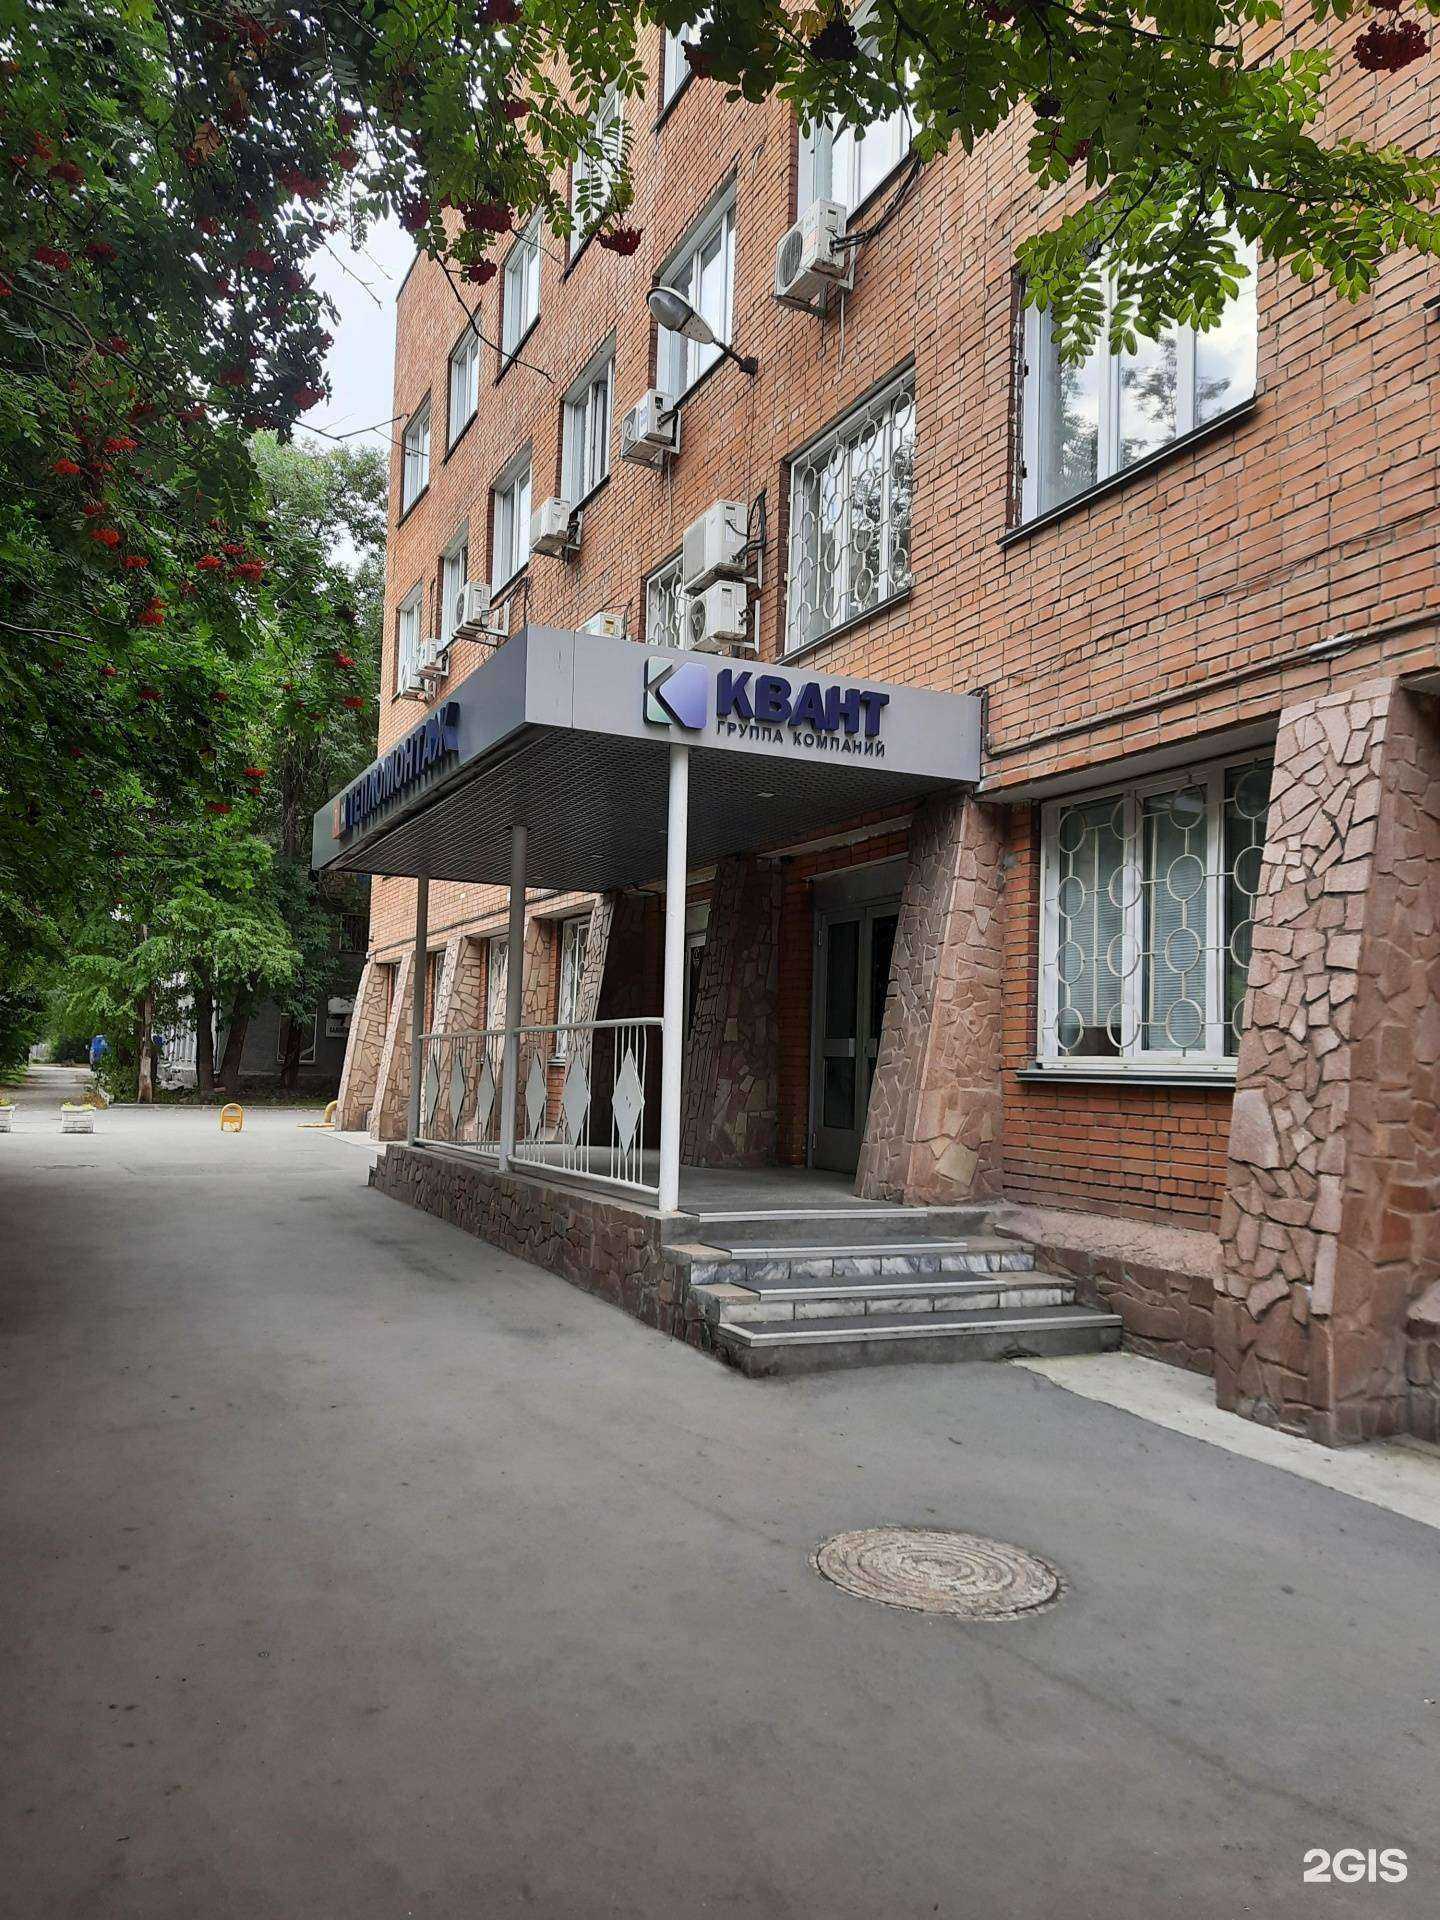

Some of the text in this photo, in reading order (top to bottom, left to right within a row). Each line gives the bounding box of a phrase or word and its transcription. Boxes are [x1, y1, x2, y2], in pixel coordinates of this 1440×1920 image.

[717, 668, 890, 738] КВАНТ
[717, 720, 886, 758] ГРУППА КОМПАНИЙ
